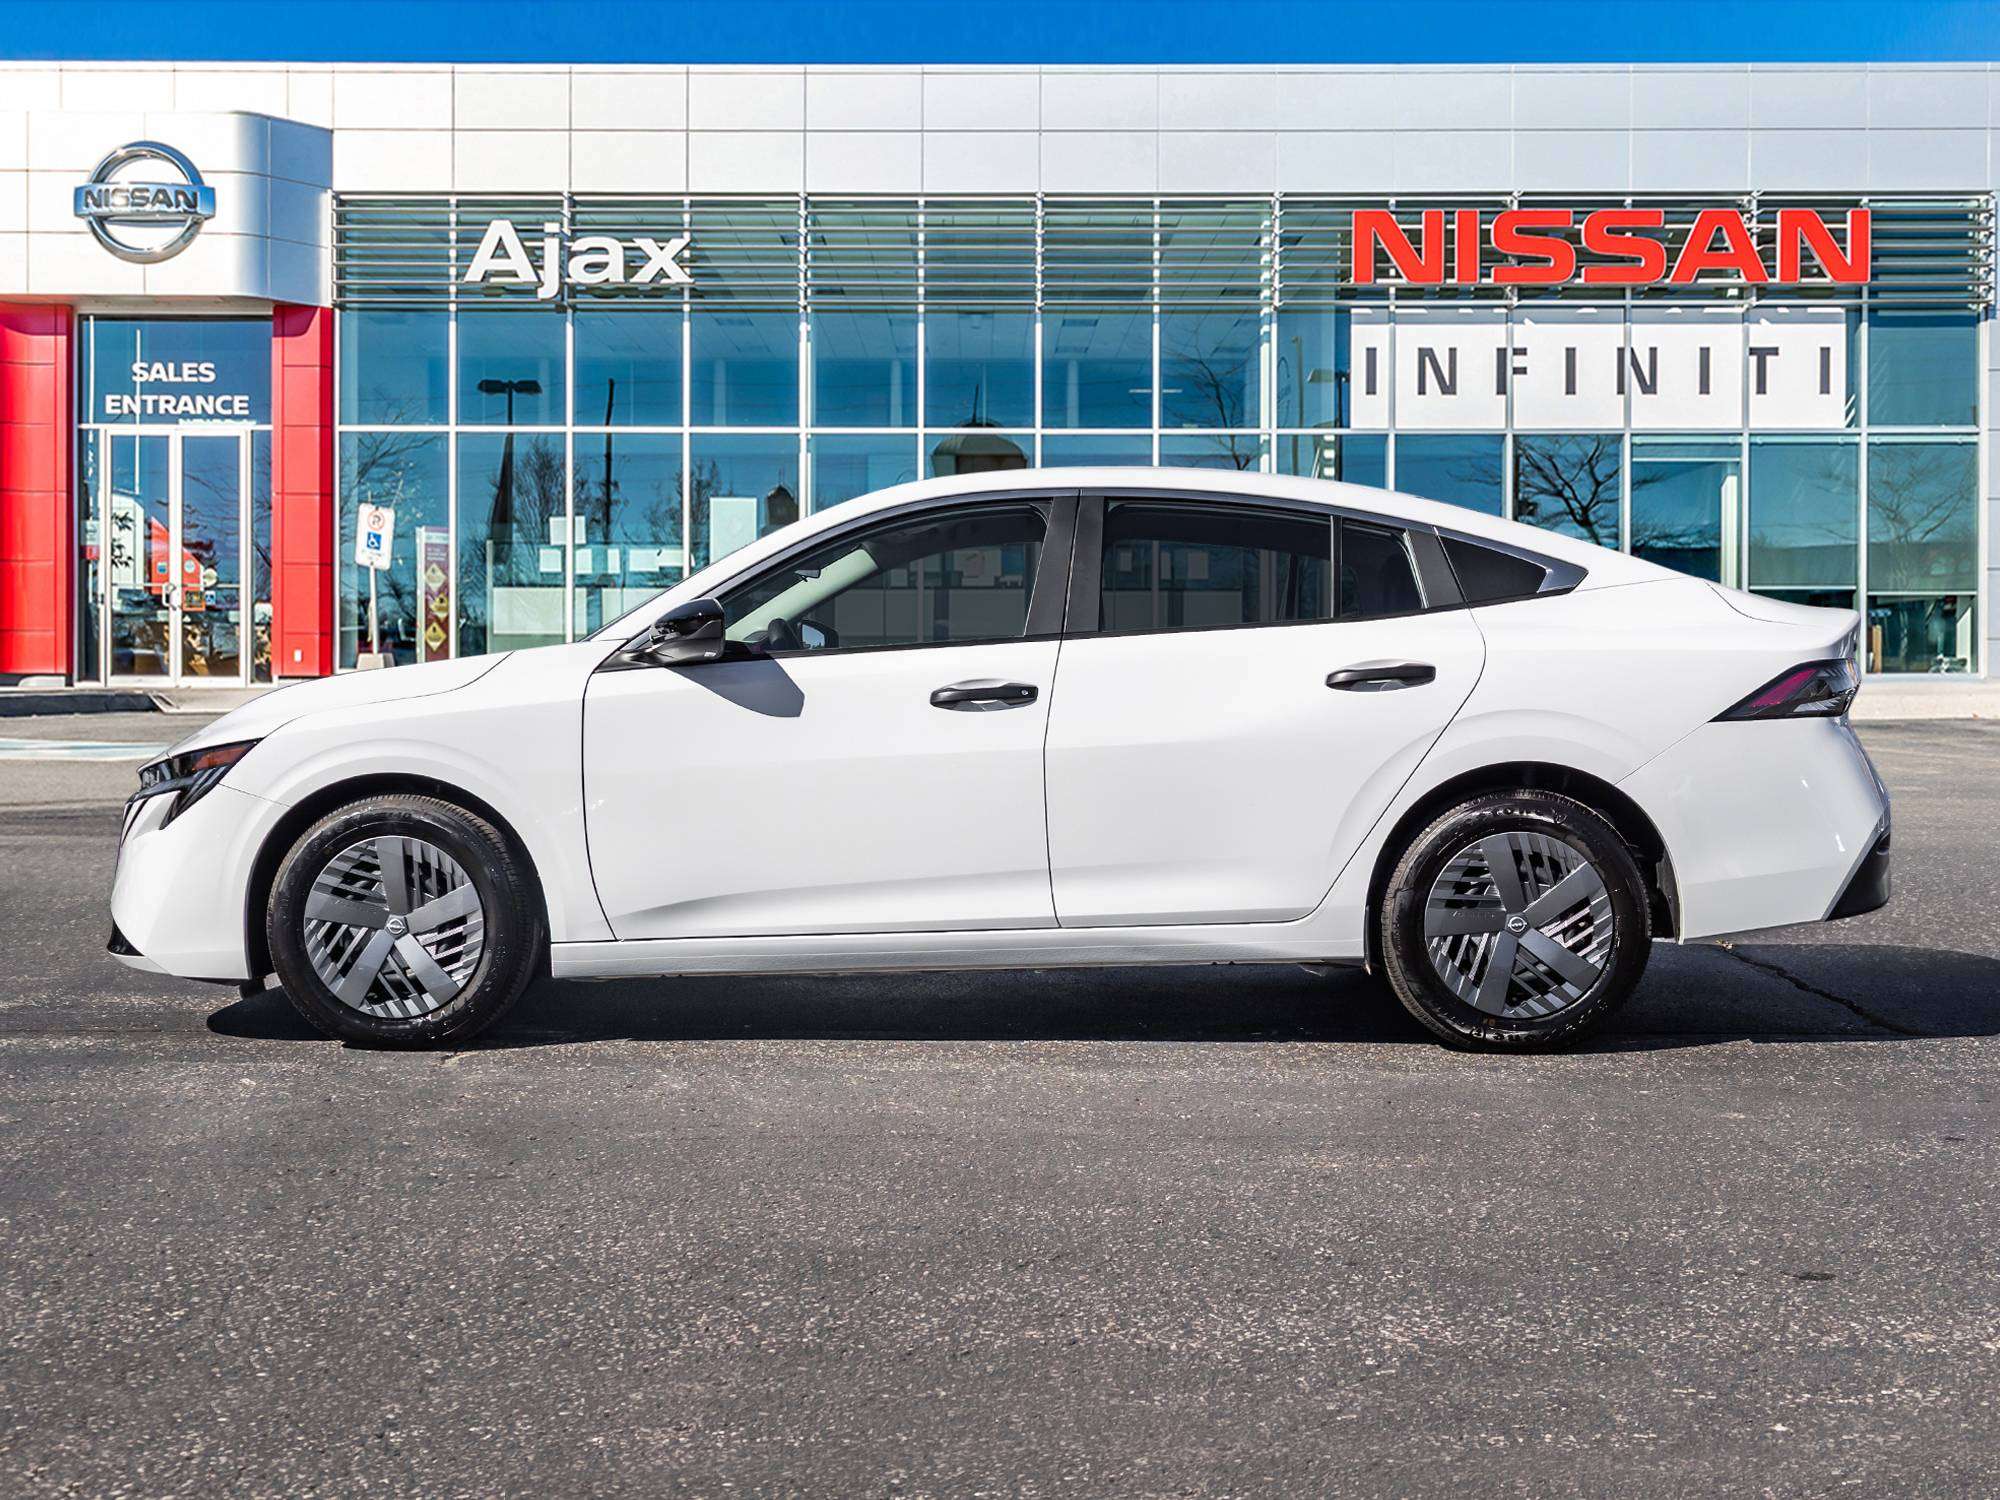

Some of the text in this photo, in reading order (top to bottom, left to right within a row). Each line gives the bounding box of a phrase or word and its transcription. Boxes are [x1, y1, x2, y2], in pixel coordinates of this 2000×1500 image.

[84, 187, 198, 209] NISSAN
[463, 219, 696, 301] Ajax
[1352, 208, 1872, 285] NISSAN
[131, 362, 216, 383] SALES
[1365, 346, 1831, 397] INFINITI
[105, 394, 250, 415] ENTRANCE
